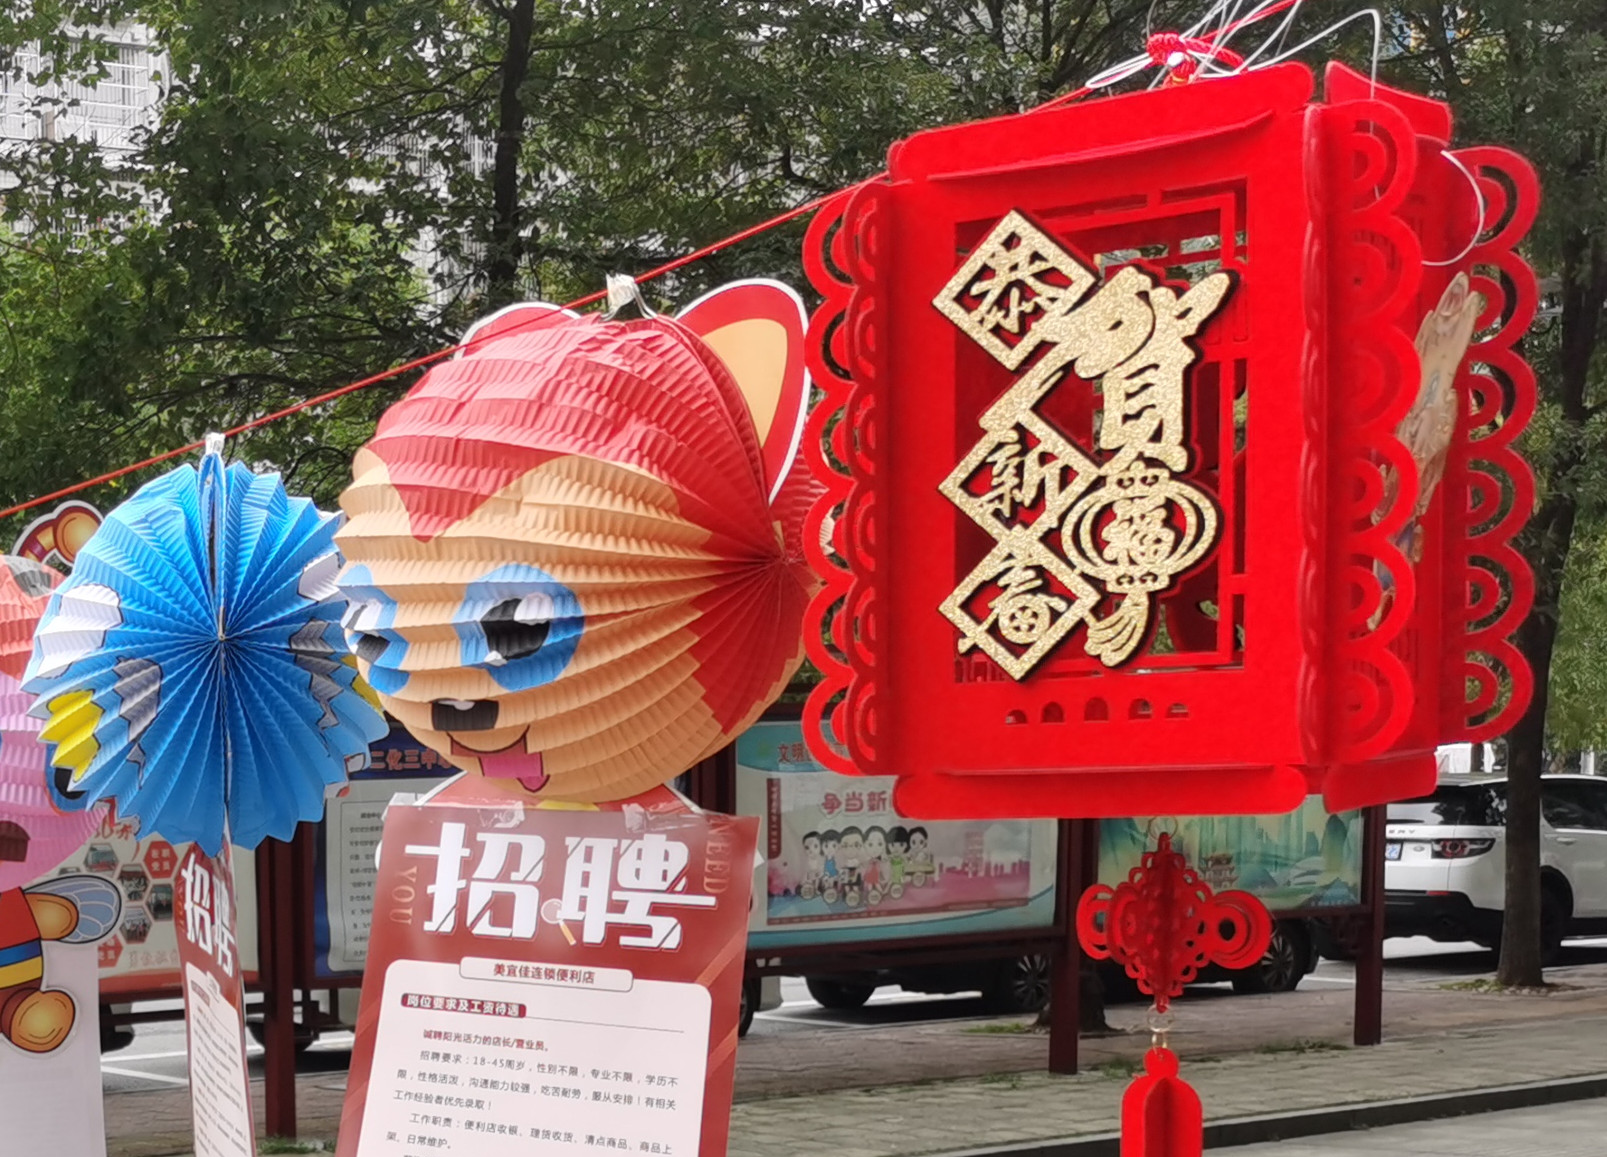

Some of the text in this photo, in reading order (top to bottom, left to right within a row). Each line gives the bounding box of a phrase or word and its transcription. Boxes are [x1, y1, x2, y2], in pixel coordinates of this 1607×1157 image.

[821, 789, 894, 814] 争当新
[703, 813, 737, 894] NEED
[389, 865, 419, 925] YOU
[404, 821, 717, 950] 招聘
[493, 963, 596, 984] 美宜佳连锁便利店
[406, 994, 520, 1017] 岗位要求及工资待遇
